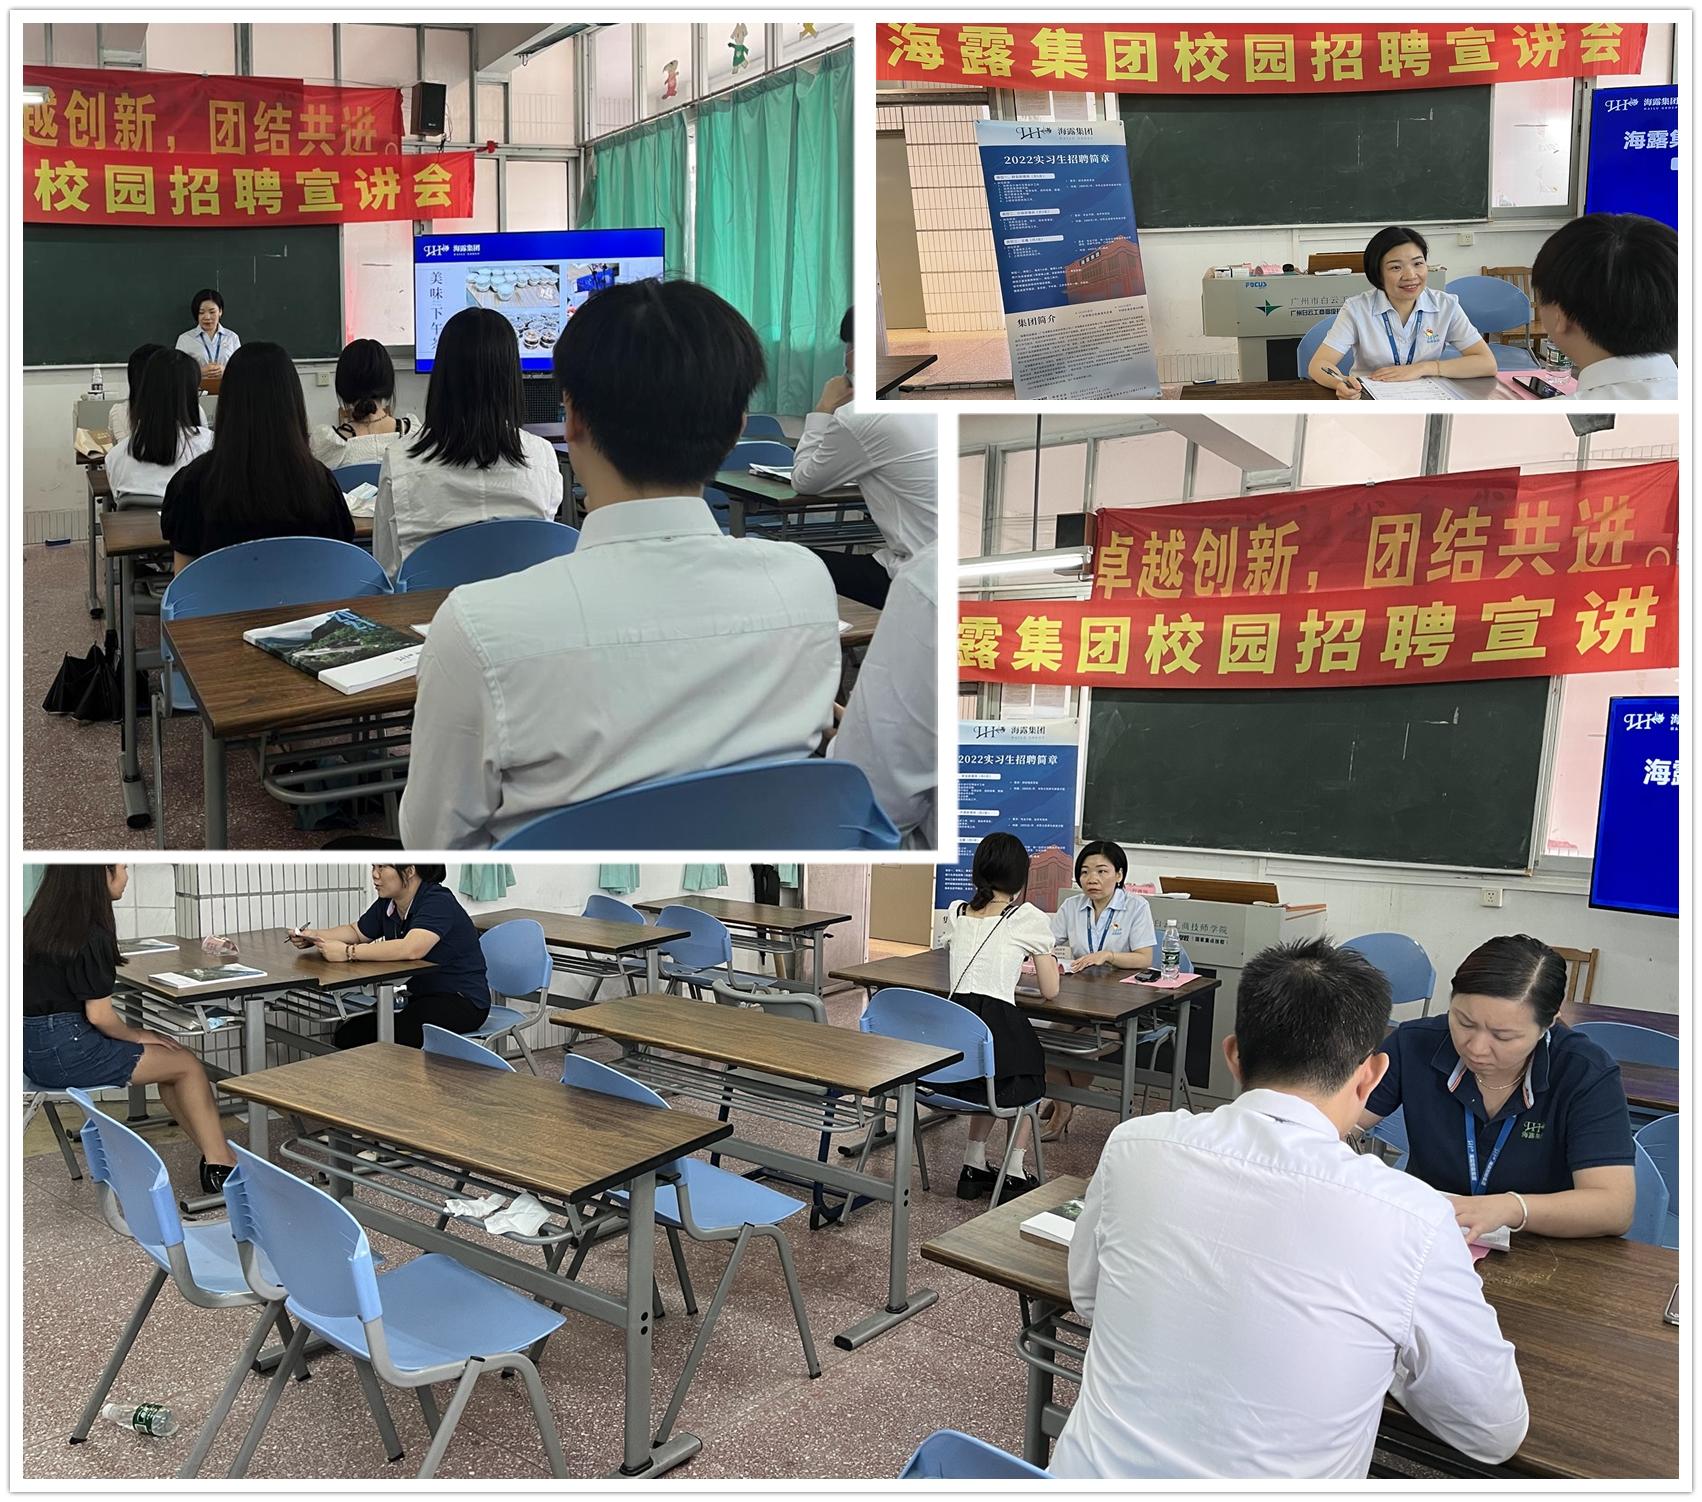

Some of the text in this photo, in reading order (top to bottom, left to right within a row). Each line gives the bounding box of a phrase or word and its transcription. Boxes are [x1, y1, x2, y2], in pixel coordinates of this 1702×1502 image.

[887, 23, 1624, 82] 海露集团校园招聘宣讲会
[1057, 127, 1094, 136] 海露集团
[1003, 153, 1110, 165] 2022实习生招聘简章
[34, 158, 452, 216] 校园招聘宣讲会
[1017, 314, 1057, 328] 集团简介
[1010, 726, 1046, 735] 海露集团
